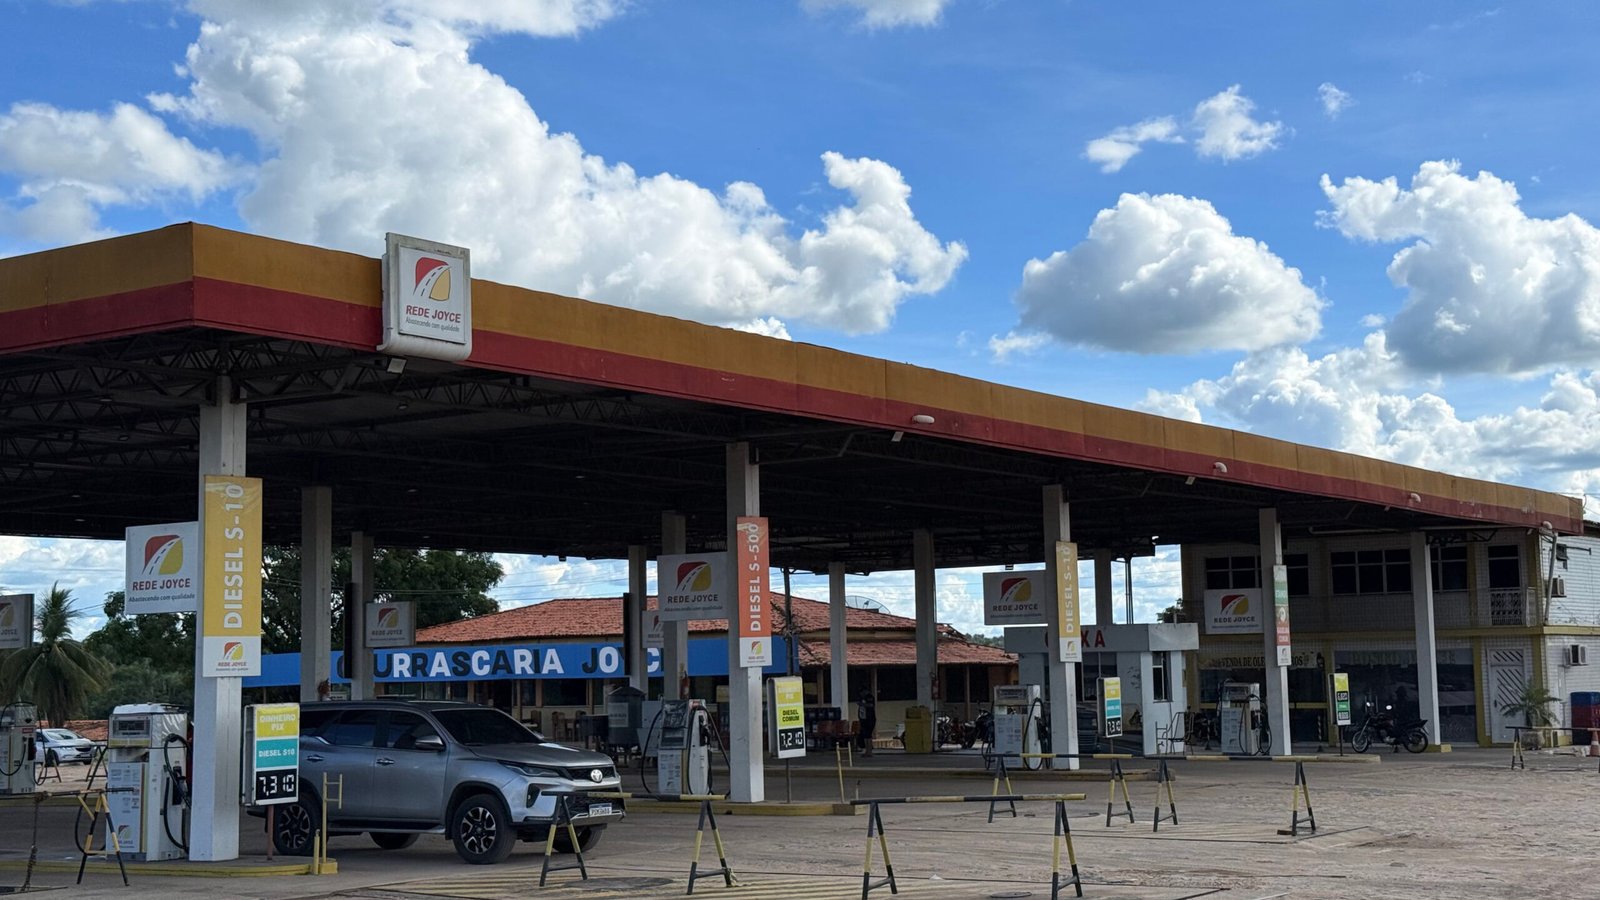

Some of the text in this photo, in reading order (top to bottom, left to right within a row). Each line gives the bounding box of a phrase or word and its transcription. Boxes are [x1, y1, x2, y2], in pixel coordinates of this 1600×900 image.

[406, 305, 461, 323] REDE JOYCE
[441, 323, 460, 332] qualidade
[224, 484, 244, 628] DIESEL S-10
[748, 523, 761, 632] DIESEL S-500
[132, 578, 191, 591] REDE JOYCE
[1063, 545, 1074, 633] DIESEL S-10
[172, 593, 195, 601] qualidade
[667, 594, 718, 604] REDE JOYCE
[337, 646, 664, 679] URRASCARIA JOC
[1243, 657, 1252, 667] DE
[260, 713, 296, 723] DINHEIRO
[271, 723, 285, 731] PIX
[781, 731, 803, 748] 7,210
[258, 748, 295, 758] DIESEL S10
[259, 774, 295, 796] 7,310
